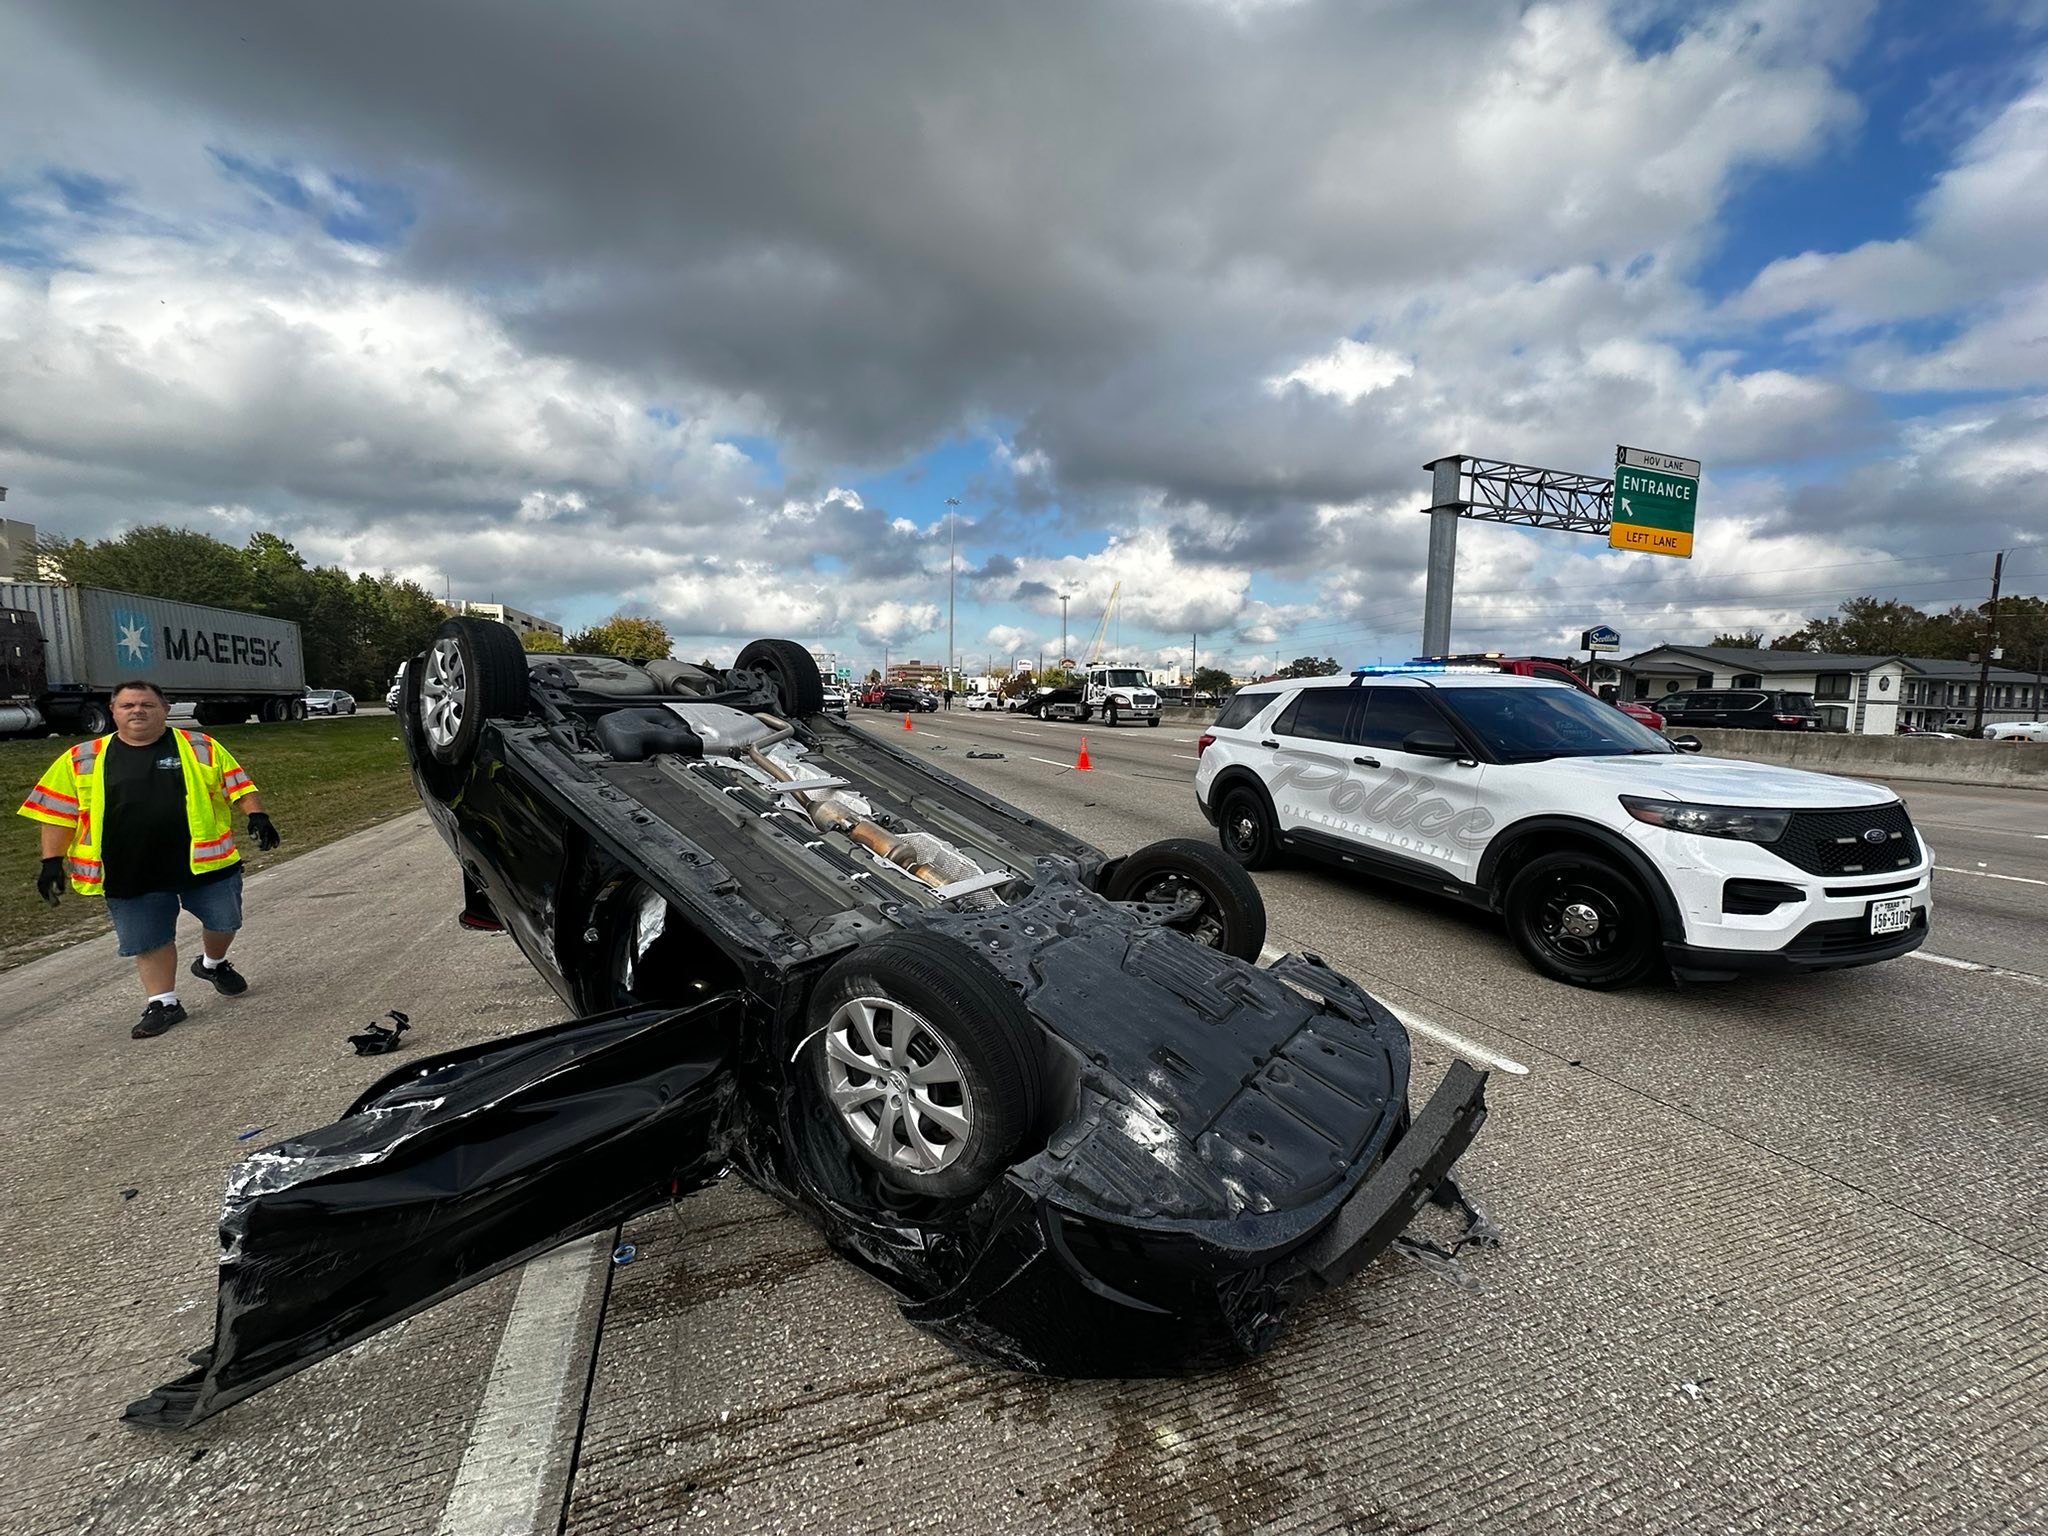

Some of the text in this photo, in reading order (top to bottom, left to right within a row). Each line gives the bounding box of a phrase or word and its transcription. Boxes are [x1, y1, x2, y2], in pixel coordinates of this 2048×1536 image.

[1643, 455, 1684, 471] HOV LANE
[1622, 475, 1690, 500] ENTRANCE
[1626, 531, 1678, 548] LEFT LANE
[162, 626, 282, 668] MAERSK
[1268, 750, 1495, 850] Police
[1283, 804, 1454, 859] OAK RIDGE NORTH
